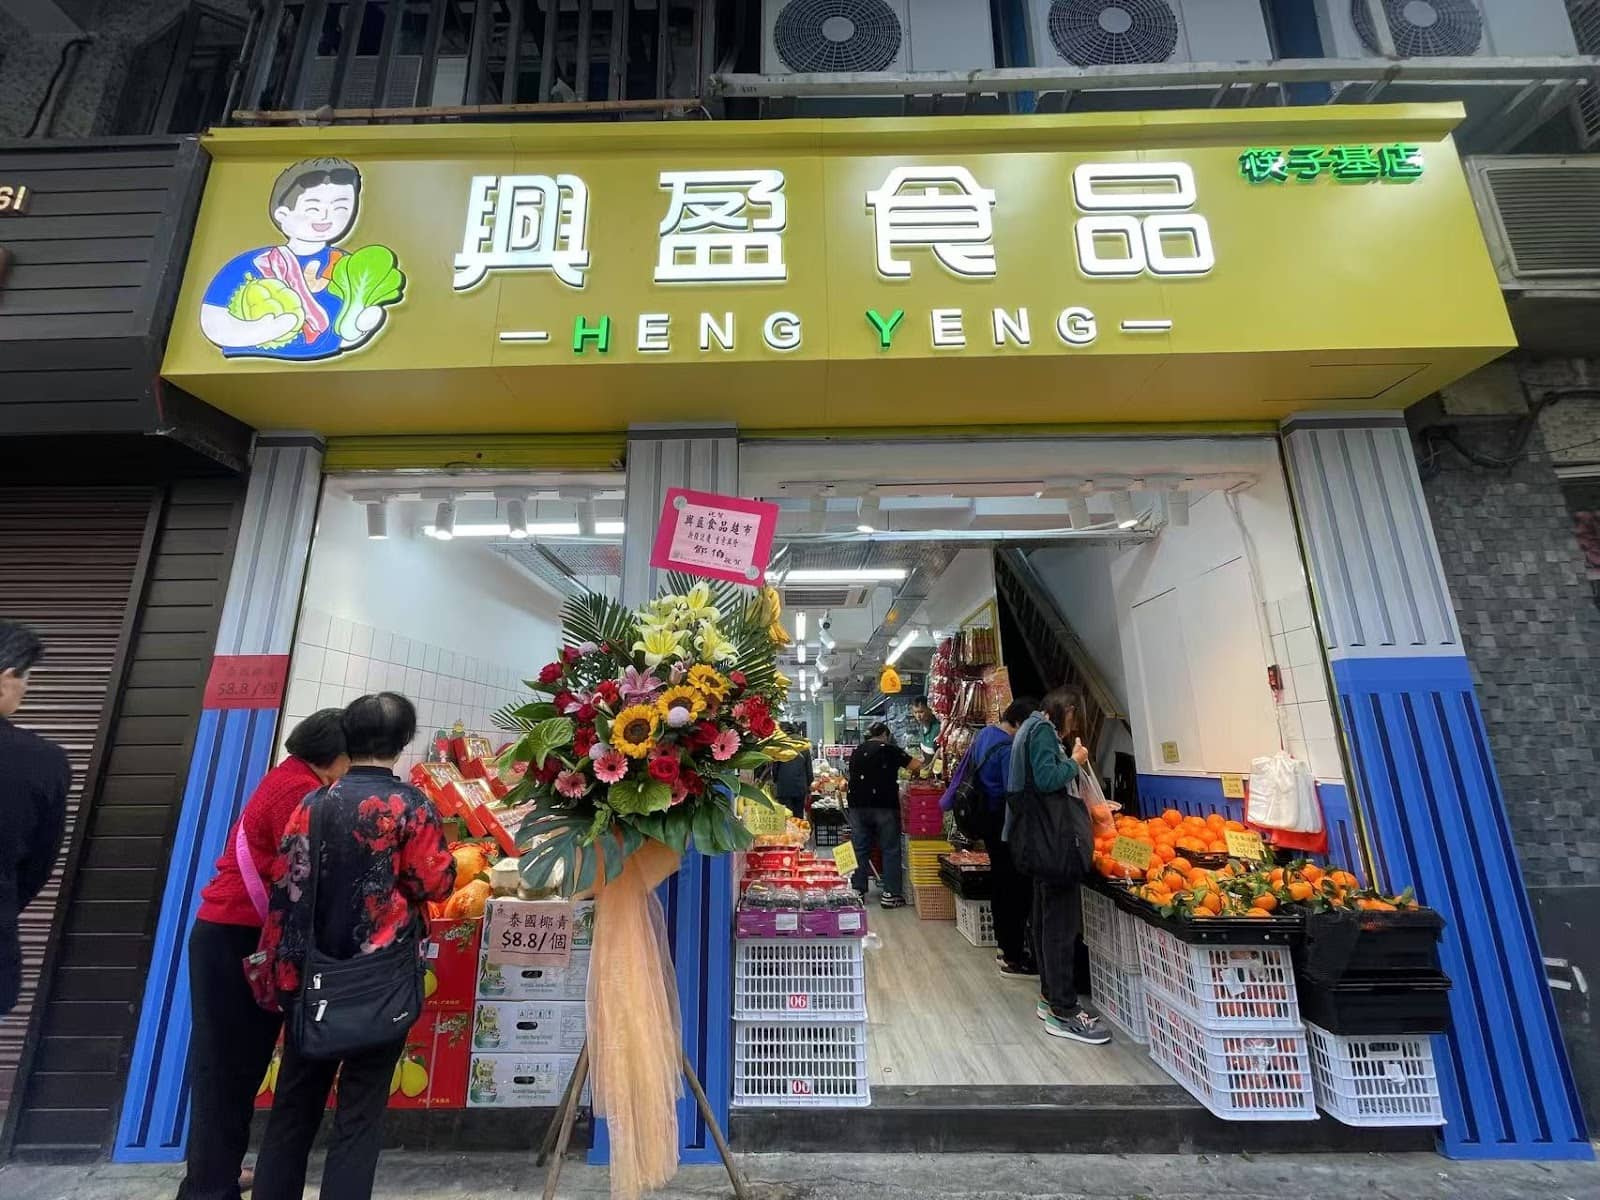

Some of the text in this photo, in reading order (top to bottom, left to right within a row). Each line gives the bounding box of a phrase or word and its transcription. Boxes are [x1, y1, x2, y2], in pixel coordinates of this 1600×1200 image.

[1240, 144, 1424, 182] 筷子基店
[453, 162, 1215, 290] 興盈食品
[573, 306, 1098, 352] HENG YENG
[508, 912, 569, 930] 泰國椰青
[501, 930, 567, 952] $8.8/個
